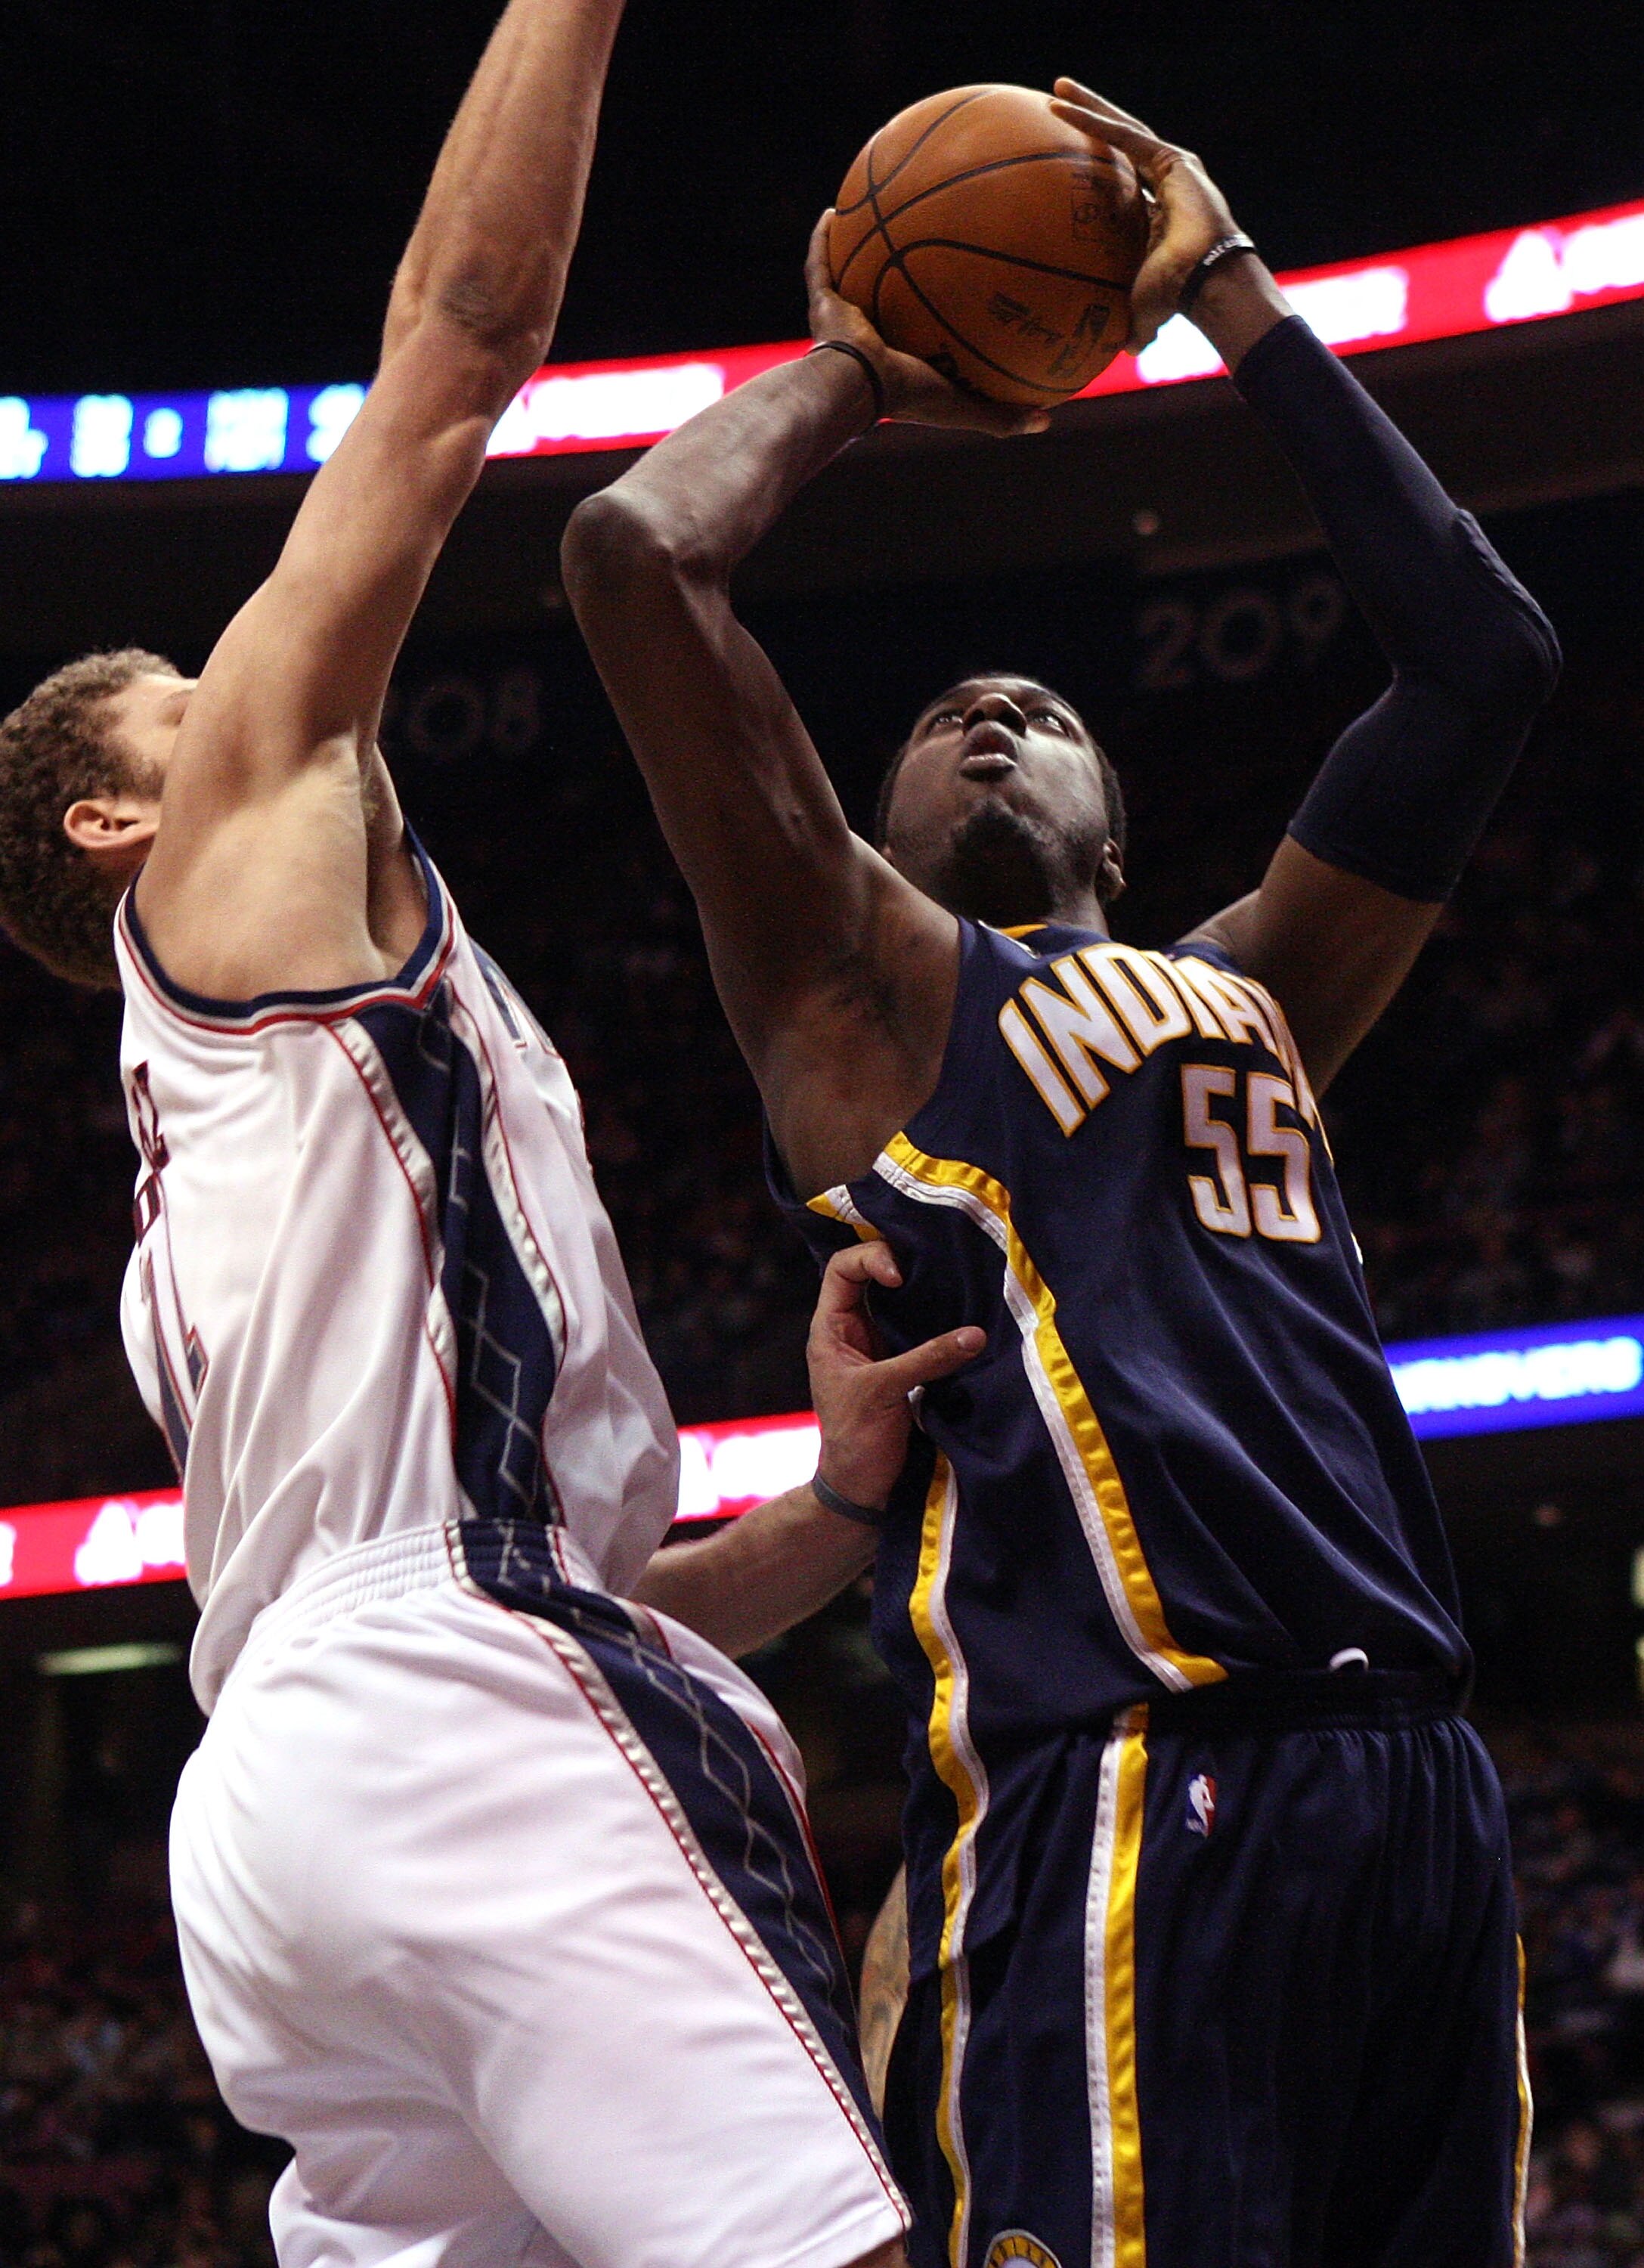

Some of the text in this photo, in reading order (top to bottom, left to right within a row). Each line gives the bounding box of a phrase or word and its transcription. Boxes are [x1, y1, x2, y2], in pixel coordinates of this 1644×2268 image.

[385, 665, 543, 764] 08
[997, 942, 1327, 1145] INDIAN
[1180, 1062, 1322, 1244] 55
